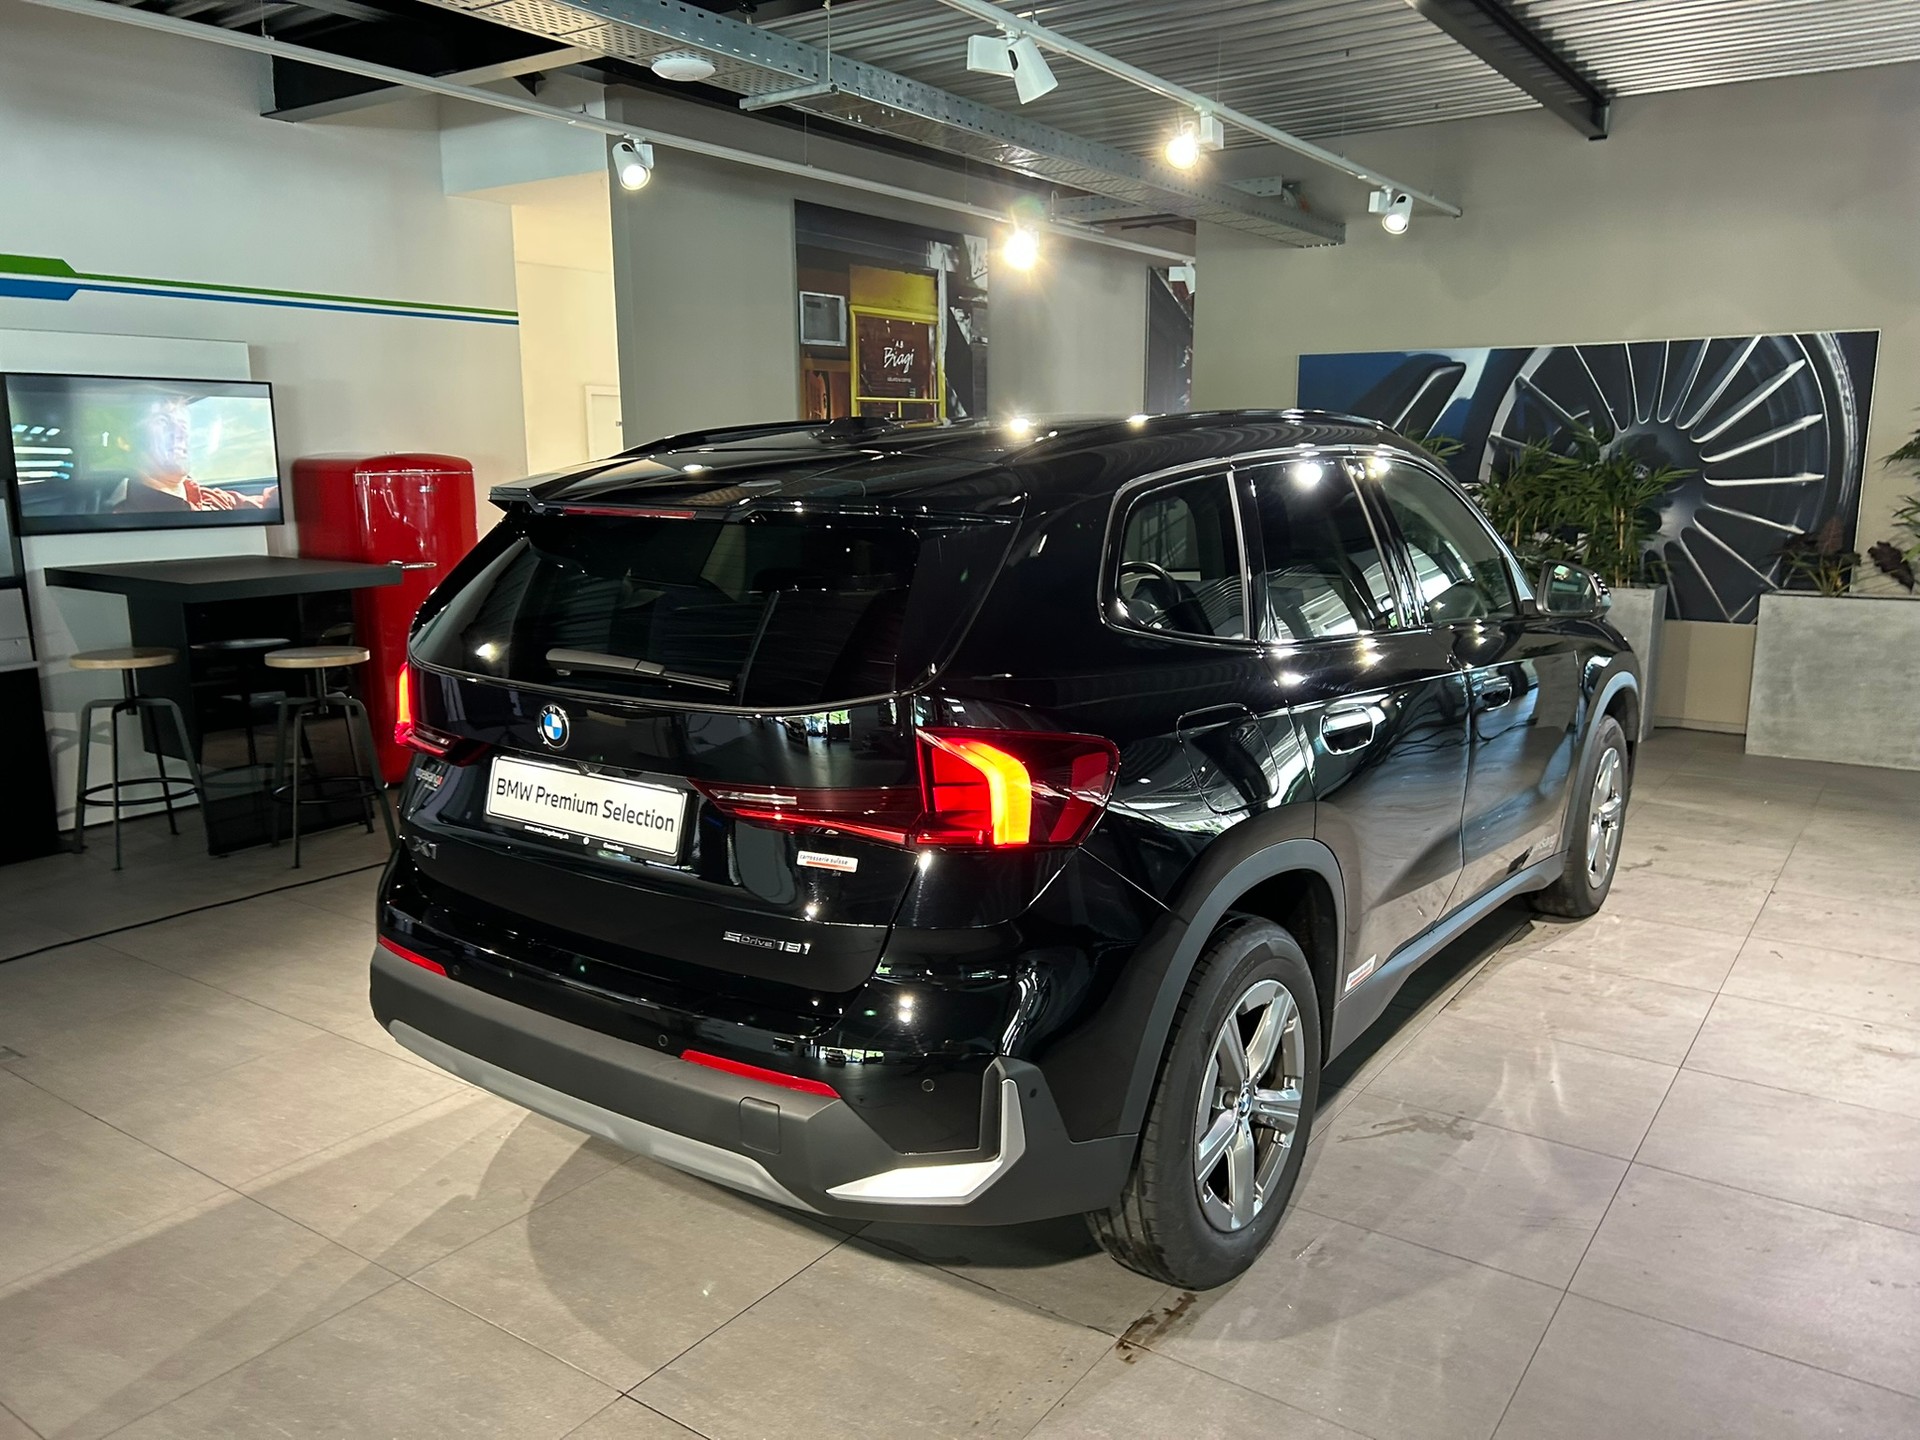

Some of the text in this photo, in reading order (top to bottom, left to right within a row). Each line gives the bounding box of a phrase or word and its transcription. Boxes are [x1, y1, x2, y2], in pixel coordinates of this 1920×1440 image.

[883, 346, 914, 374] Biagi
[496, 778, 675, 832] BMW Premium Selection
[830, 857, 848, 866] suisse
